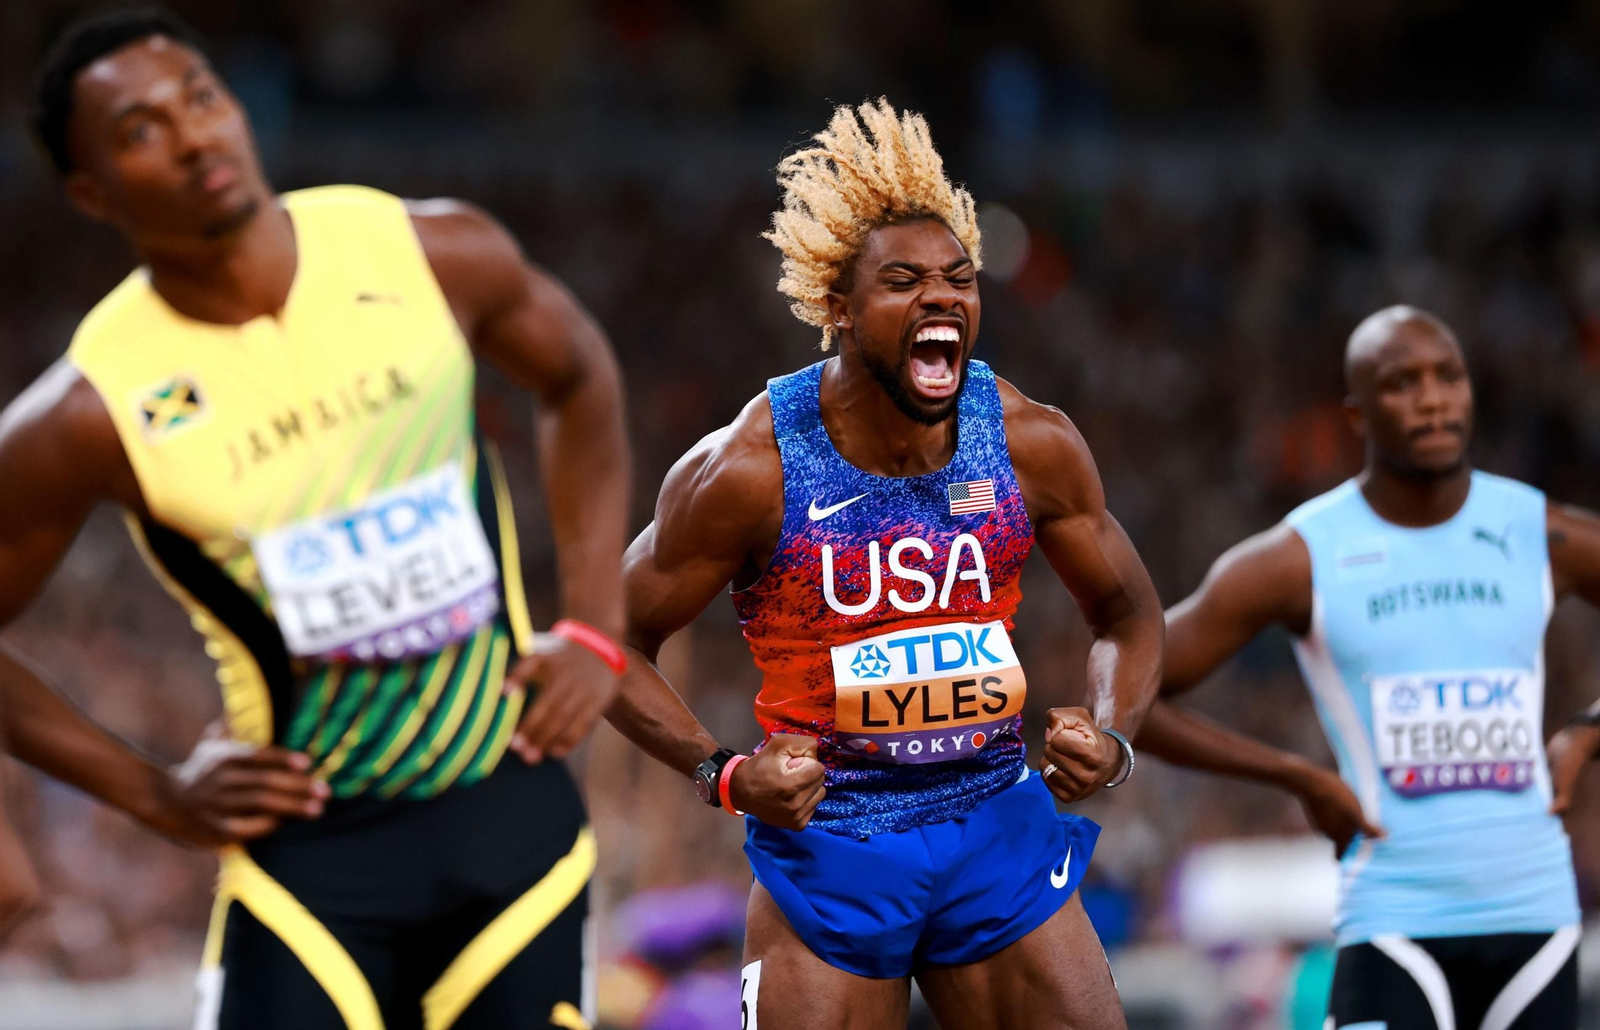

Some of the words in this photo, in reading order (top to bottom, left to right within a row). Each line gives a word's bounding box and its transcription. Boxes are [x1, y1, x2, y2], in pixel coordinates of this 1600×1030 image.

[227, 367, 414, 480] JAMAICA
[330, 480, 457, 554] TDK
[295, 548, 477, 640] LEVELL
[822, 533, 991, 616] USA
[1368, 578, 1504, 621] BOTSWANA
[887, 627, 1004, 675] TDK
[861, 676, 1008, 728] LYLES
[1424, 676, 1522, 711] TDK
[887, 731, 987, 757] TOKYO
[1387, 717, 1532, 759] TEBOGO
